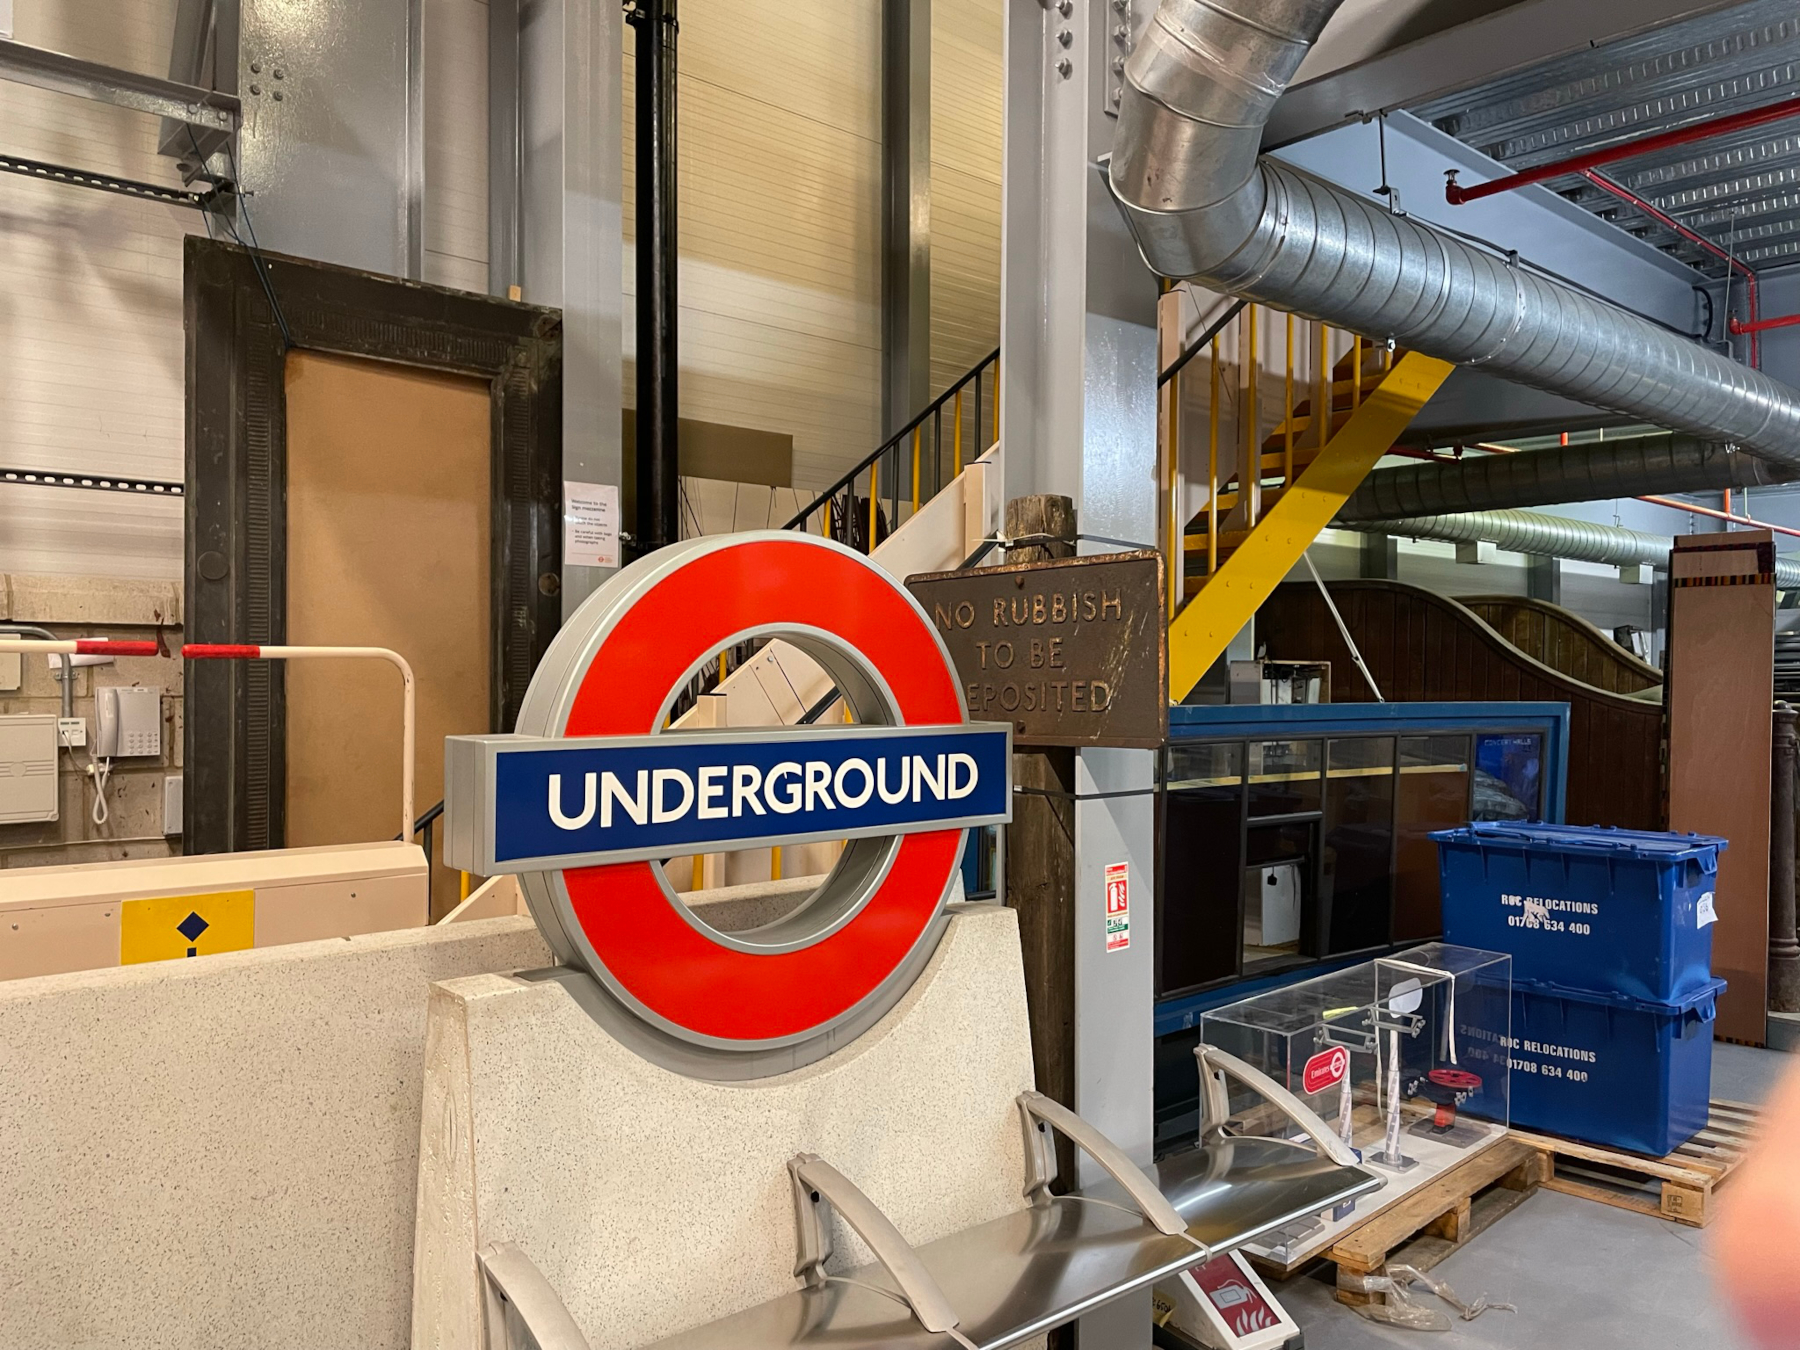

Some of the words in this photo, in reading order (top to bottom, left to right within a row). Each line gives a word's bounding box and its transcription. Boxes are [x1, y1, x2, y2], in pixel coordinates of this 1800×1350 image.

[934, 600, 976, 631] NO
[993, 589, 1123, 628] RUBBISH
[975, 639, 1015, 670] TO
[1030, 636, 1065, 669] BE
[966, 679, 1112, 713] EPOSITED
[547, 752, 979, 831] UNDERGROUND
[1543, 918, 1565, 932] 634
[1568, 922, 1590, 935] 400
[1523, 1040, 1597, 1063] RELOCATIONS
[1506, 1058, 1538, 1073] 01708
[1541, 1064, 1562, 1078] 634
[1566, 1069, 1588, 1083] 400
